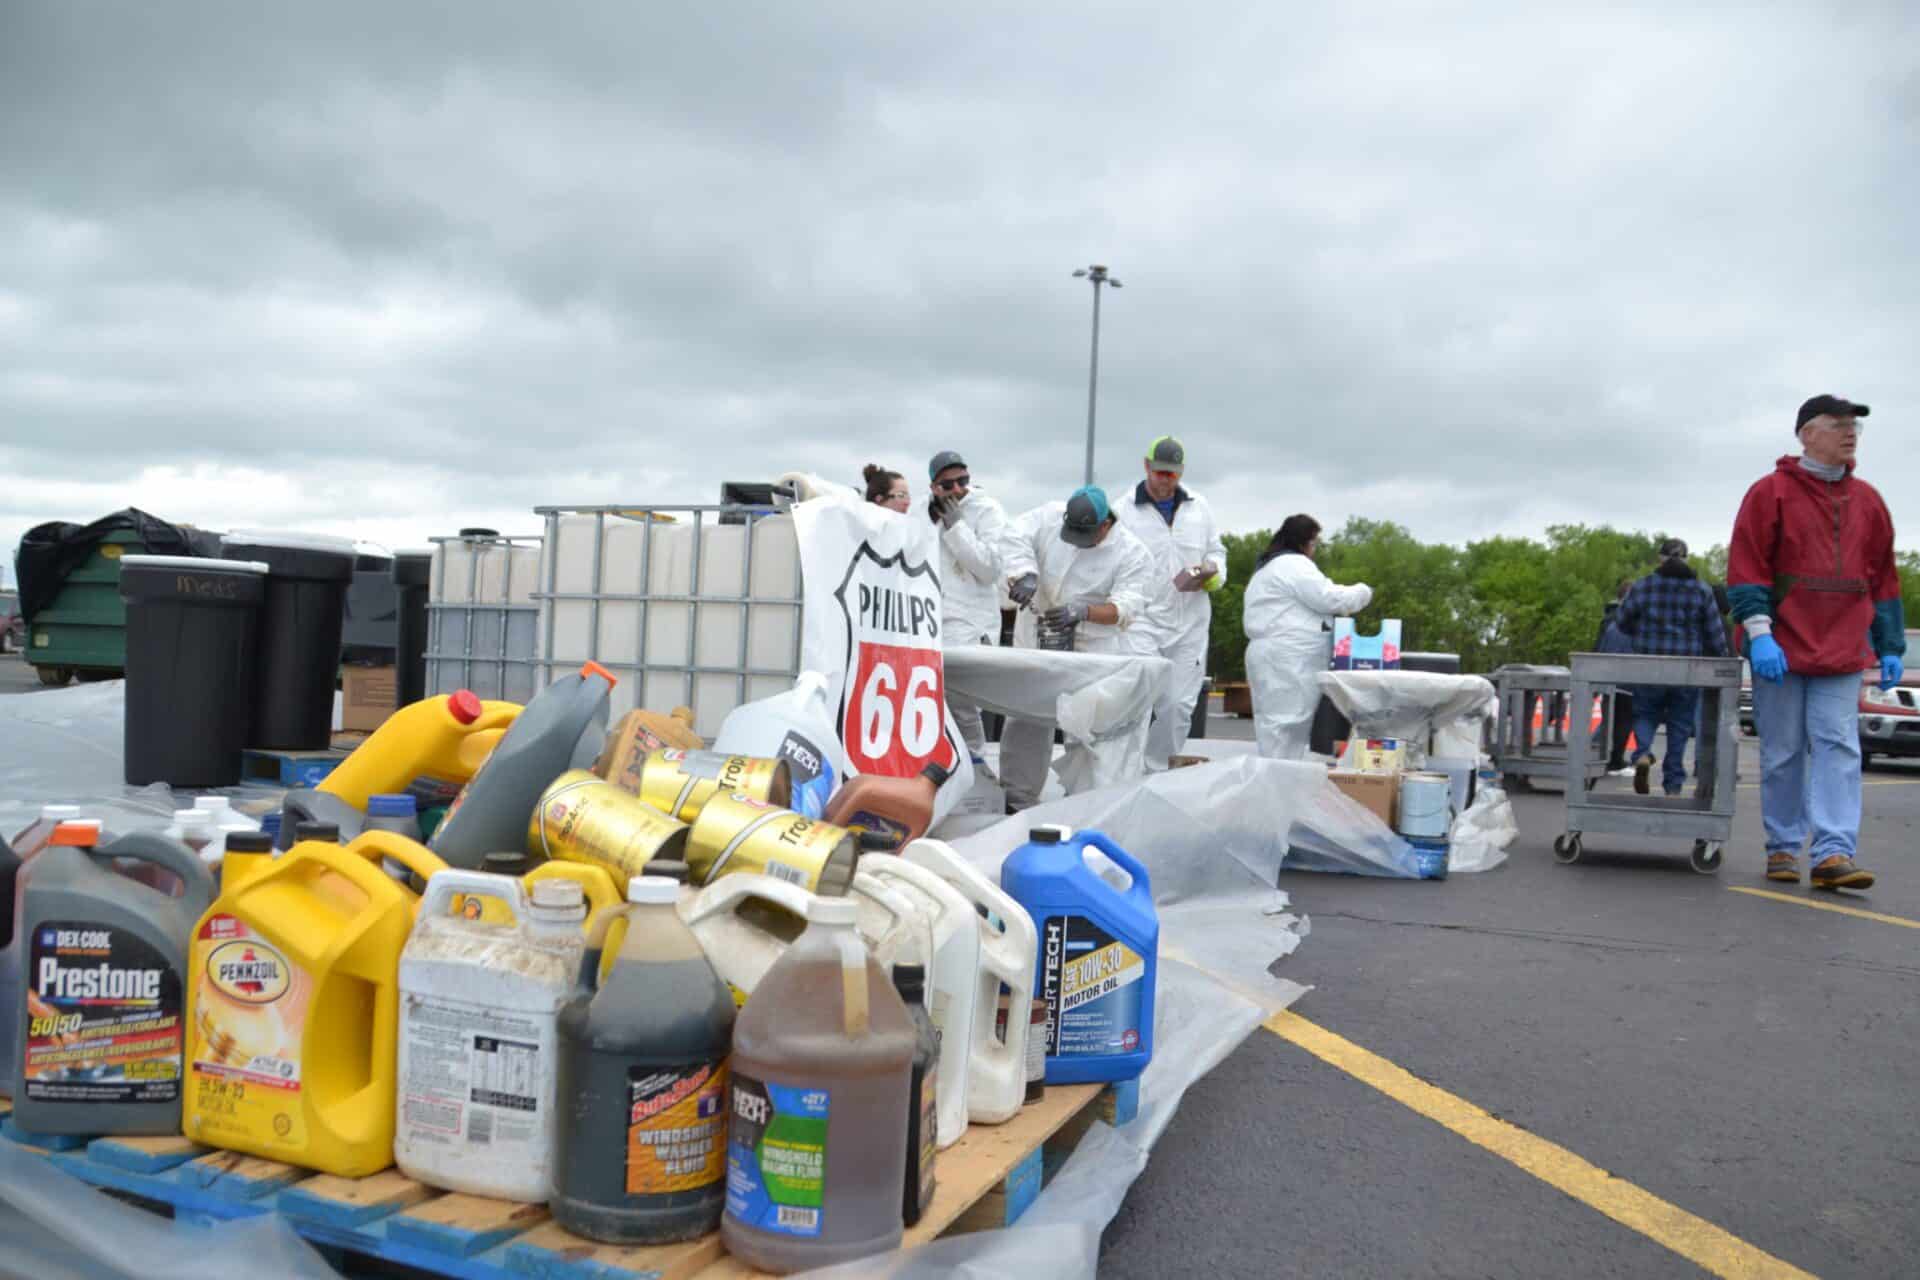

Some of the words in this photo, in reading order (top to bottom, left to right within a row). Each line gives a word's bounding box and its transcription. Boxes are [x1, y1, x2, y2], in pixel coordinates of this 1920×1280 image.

[860, 661, 940, 760] 66
[39, 957, 161, 999] Prestone
[219, 961, 279, 981] PENNZOIL
[1078, 945, 1122, 985] 10W-30
[1063, 984, 1101, 1009] MOTOR
[1103, 977, 1119, 992] OIL
[30, 1013, 83, 1037] 50/50
